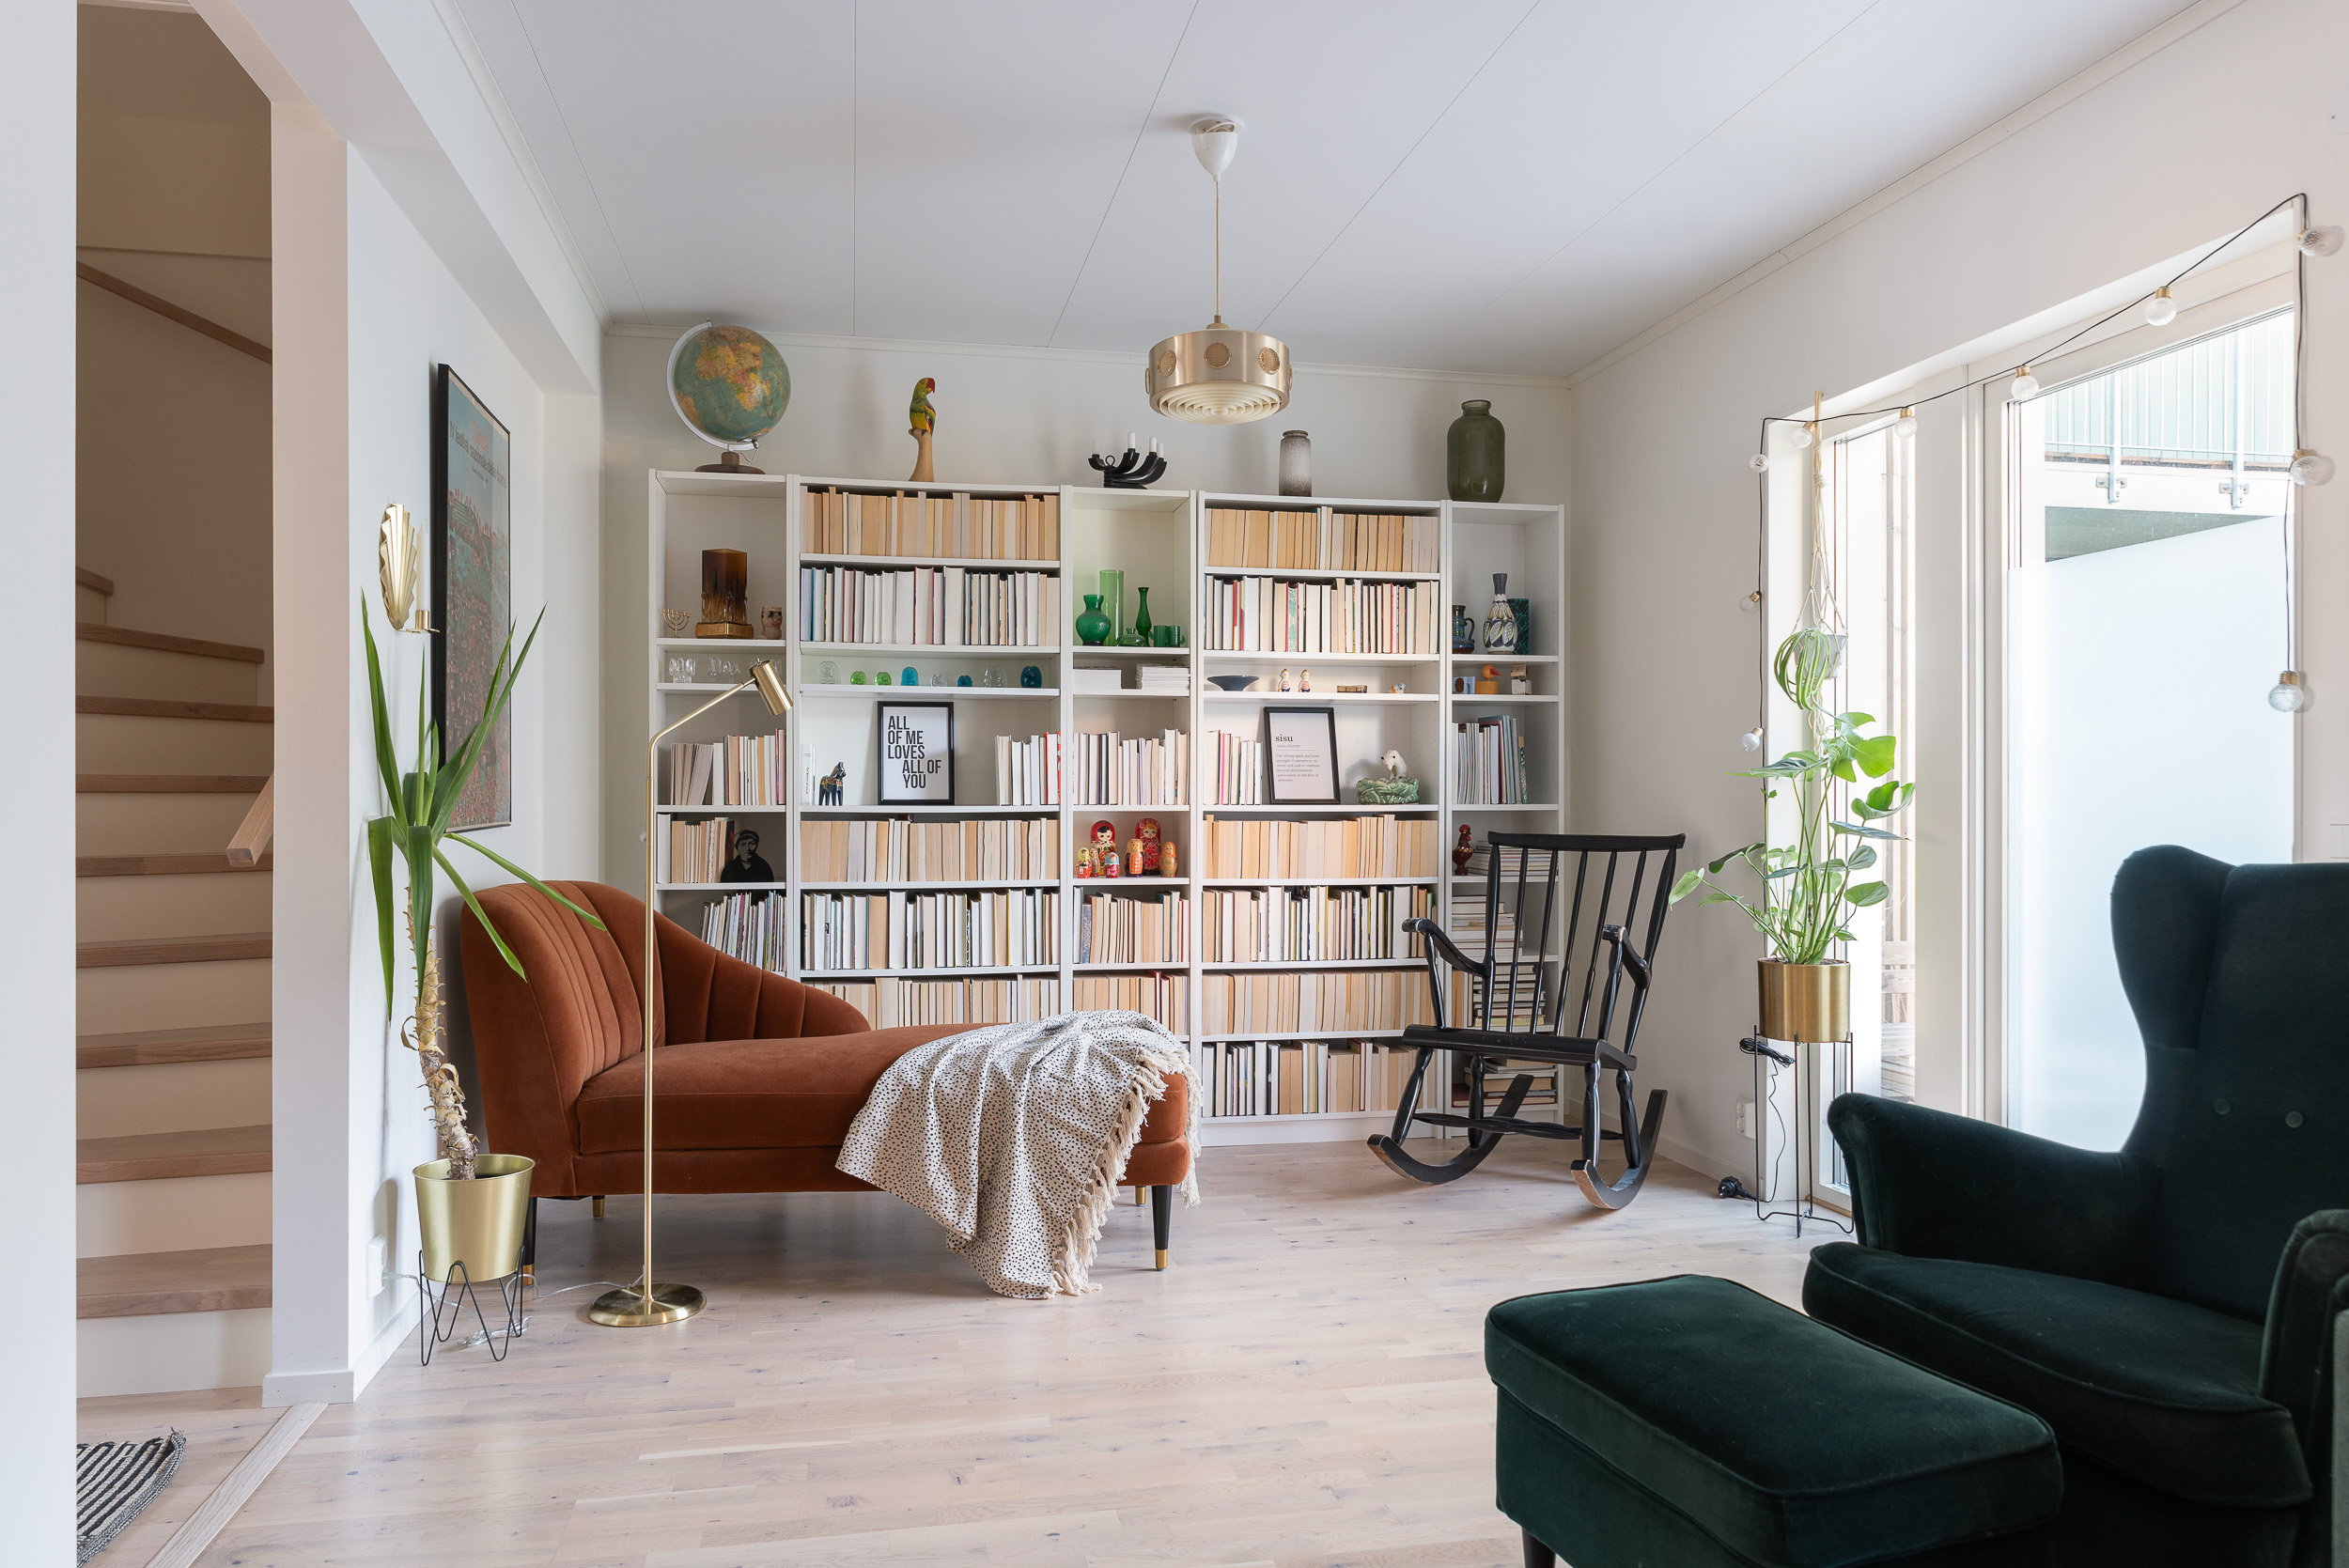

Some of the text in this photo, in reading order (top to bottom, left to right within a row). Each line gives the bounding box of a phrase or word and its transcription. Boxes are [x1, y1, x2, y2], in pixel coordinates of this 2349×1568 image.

[456, 426, 469, 455] festival
[470, 443, 487, 471] nazionale
[888, 716, 910, 730] ALL
[888, 730, 924, 744] OF ME
[1275, 734, 1294, 742] sisu
[888, 745, 926, 759] LOVES
[902, 759, 941, 773] ALL OF
[903, 774, 926, 788] YOU
